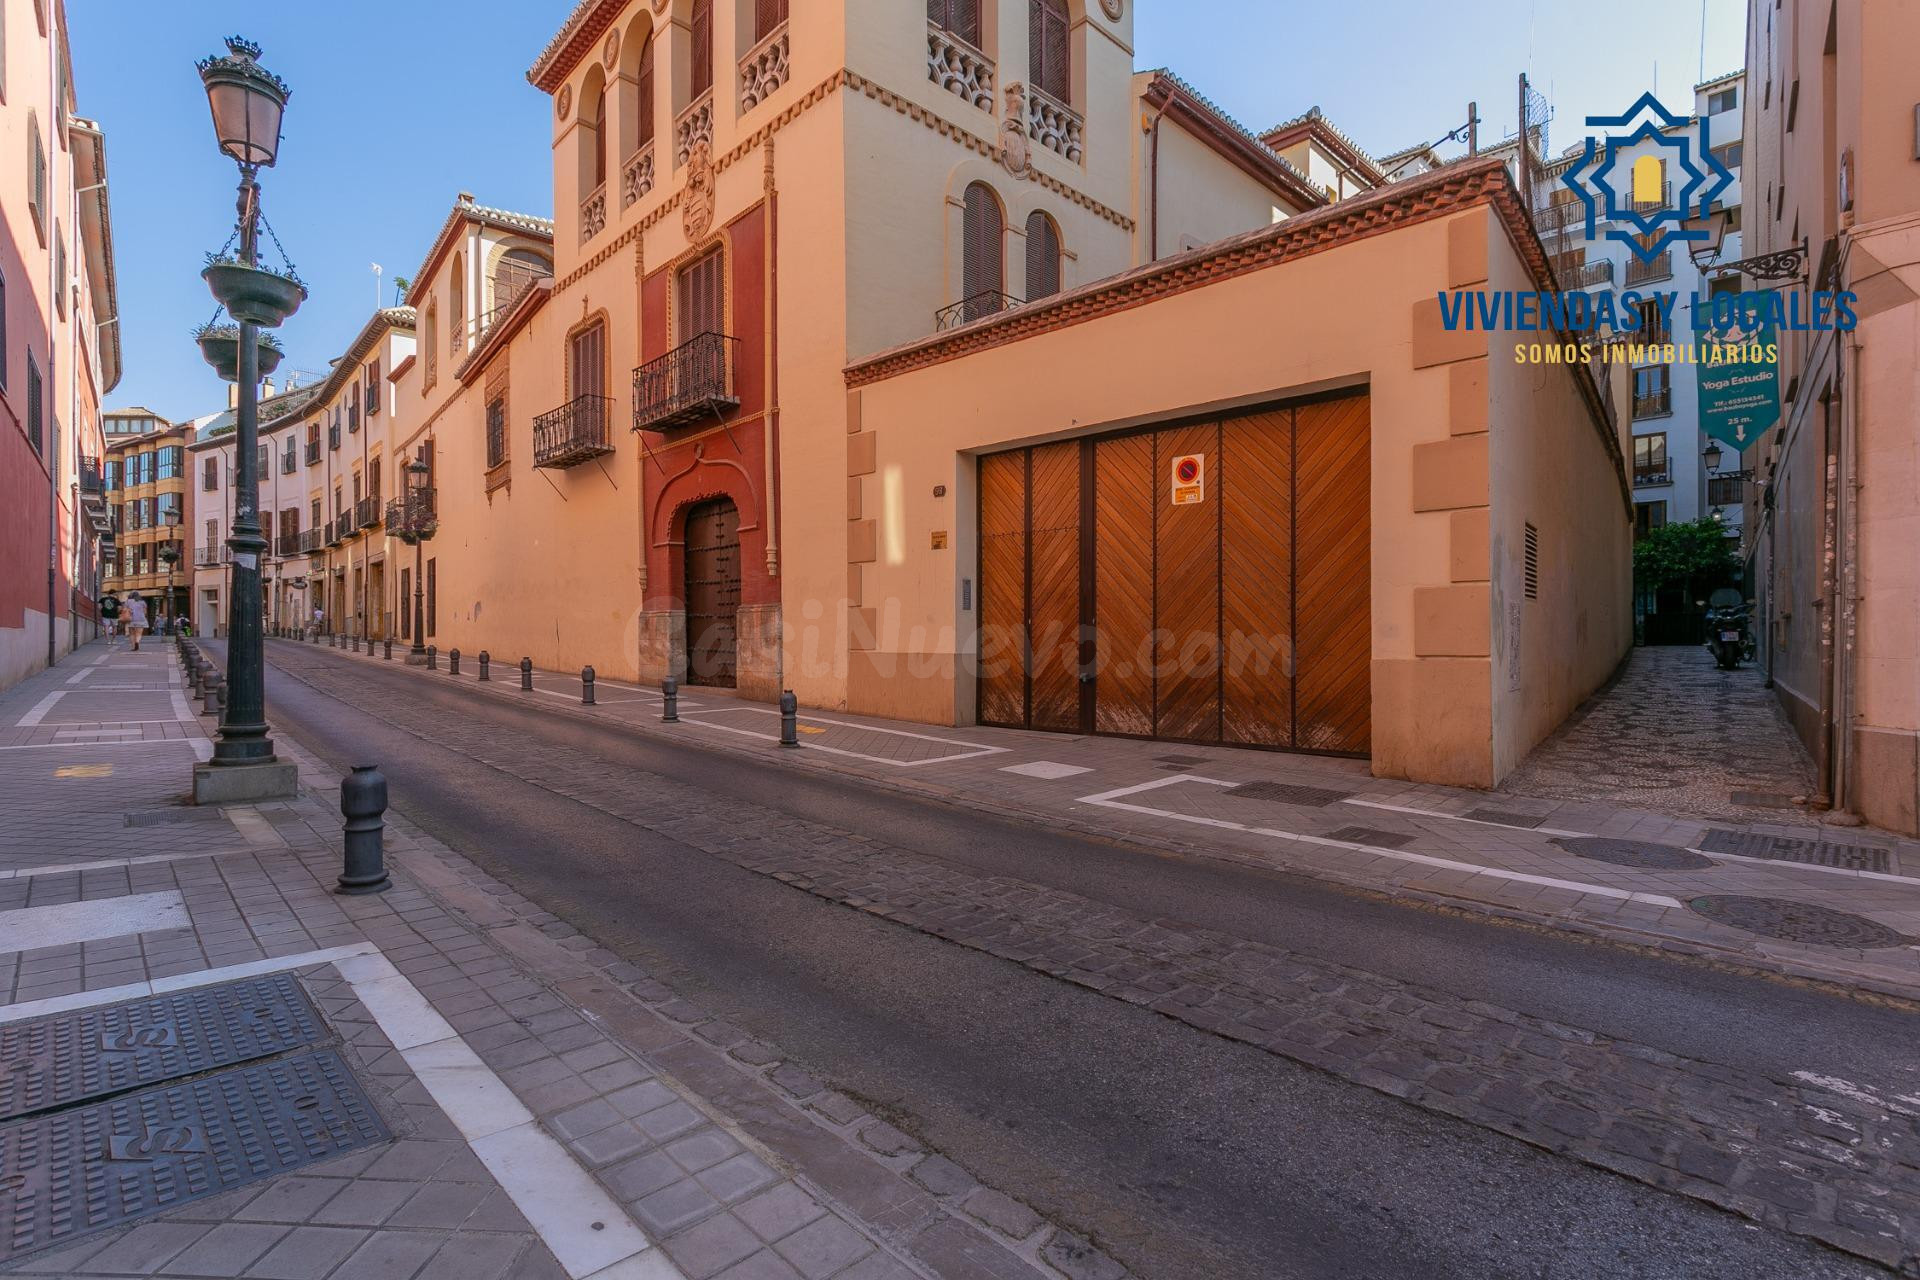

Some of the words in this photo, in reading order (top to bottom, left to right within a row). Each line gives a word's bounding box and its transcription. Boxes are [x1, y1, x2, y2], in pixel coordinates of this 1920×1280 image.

[1702, 381, 1730, 391] Yoga
[1731, 371, 1774, 386] Estudio
[1727, 417, 1739, 425] 25
